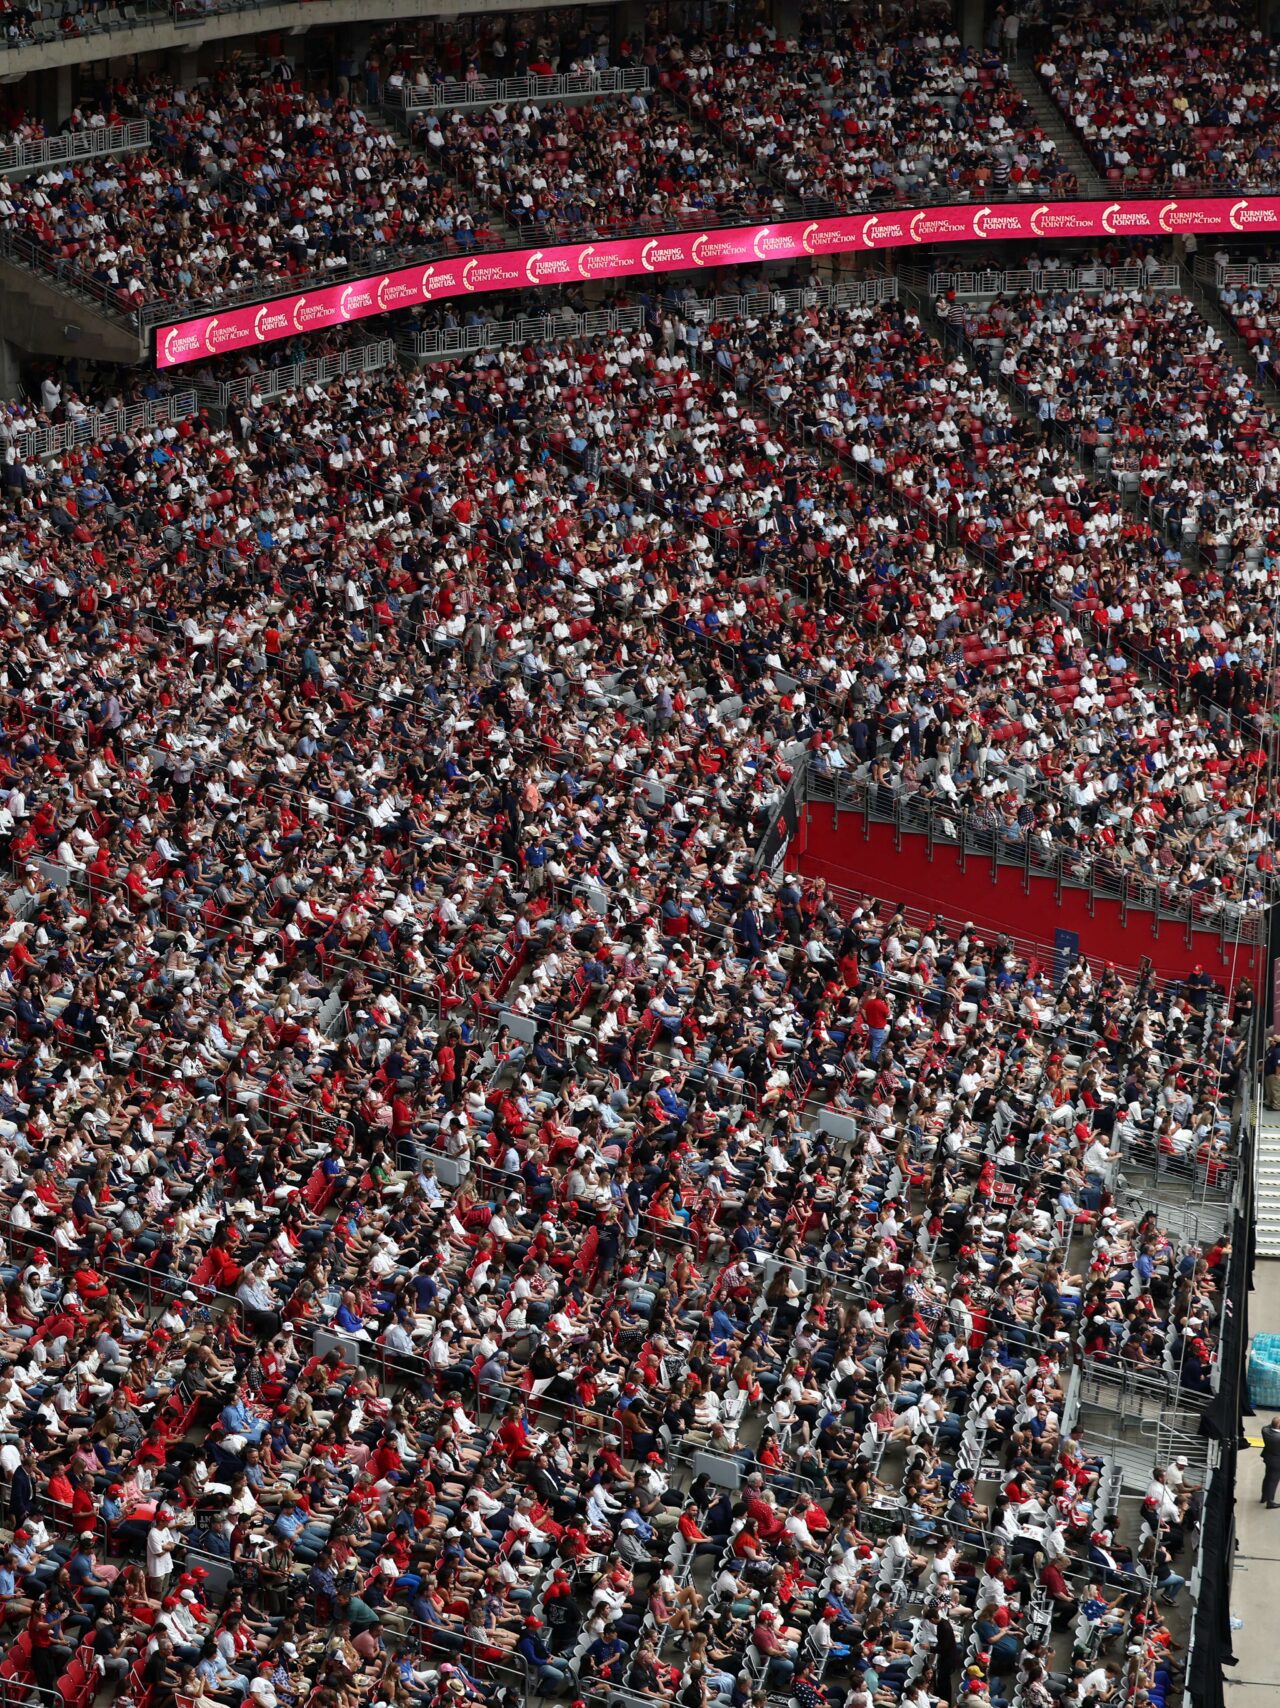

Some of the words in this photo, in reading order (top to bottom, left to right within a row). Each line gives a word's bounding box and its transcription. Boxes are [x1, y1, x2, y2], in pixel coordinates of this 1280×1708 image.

[871, 224, 900, 233] TURNING
[812, 231, 840, 239] TURNING
[763, 236, 792, 244] TURNING
[701, 243, 730, 251] TURNING
[650, 248, 681, 256] TURNING
[587, 255, 618, 263] TURNING
[536, 260, 566, 268] TURNING
[471, 267, 502, 275] TURNING
[428, 273, 452, 283] TURNING
[471, 274, 491, 282] POINT
[493, 271, 518, 279] ACTION
[384, 284, 406, 294] TURNING
[428, 281, 444, 289] POINT
[347, 293, 370, 303] TURNING
[384, 292, 399, 300] POINT
[347, 301, 362, 309] POINT
[300, 304, 323, 315] TURNING
[262, 314, 285, 324] TURNING
[300, 312, 316, 321] POINT
[261, 322, 278, 330] POINT
[213, 325, 236, 336] TURNING
[172, 335, 197, 345] TURNING
[213, 334, 229, 342] POINT
[172, 344, 188, 352] POINT
